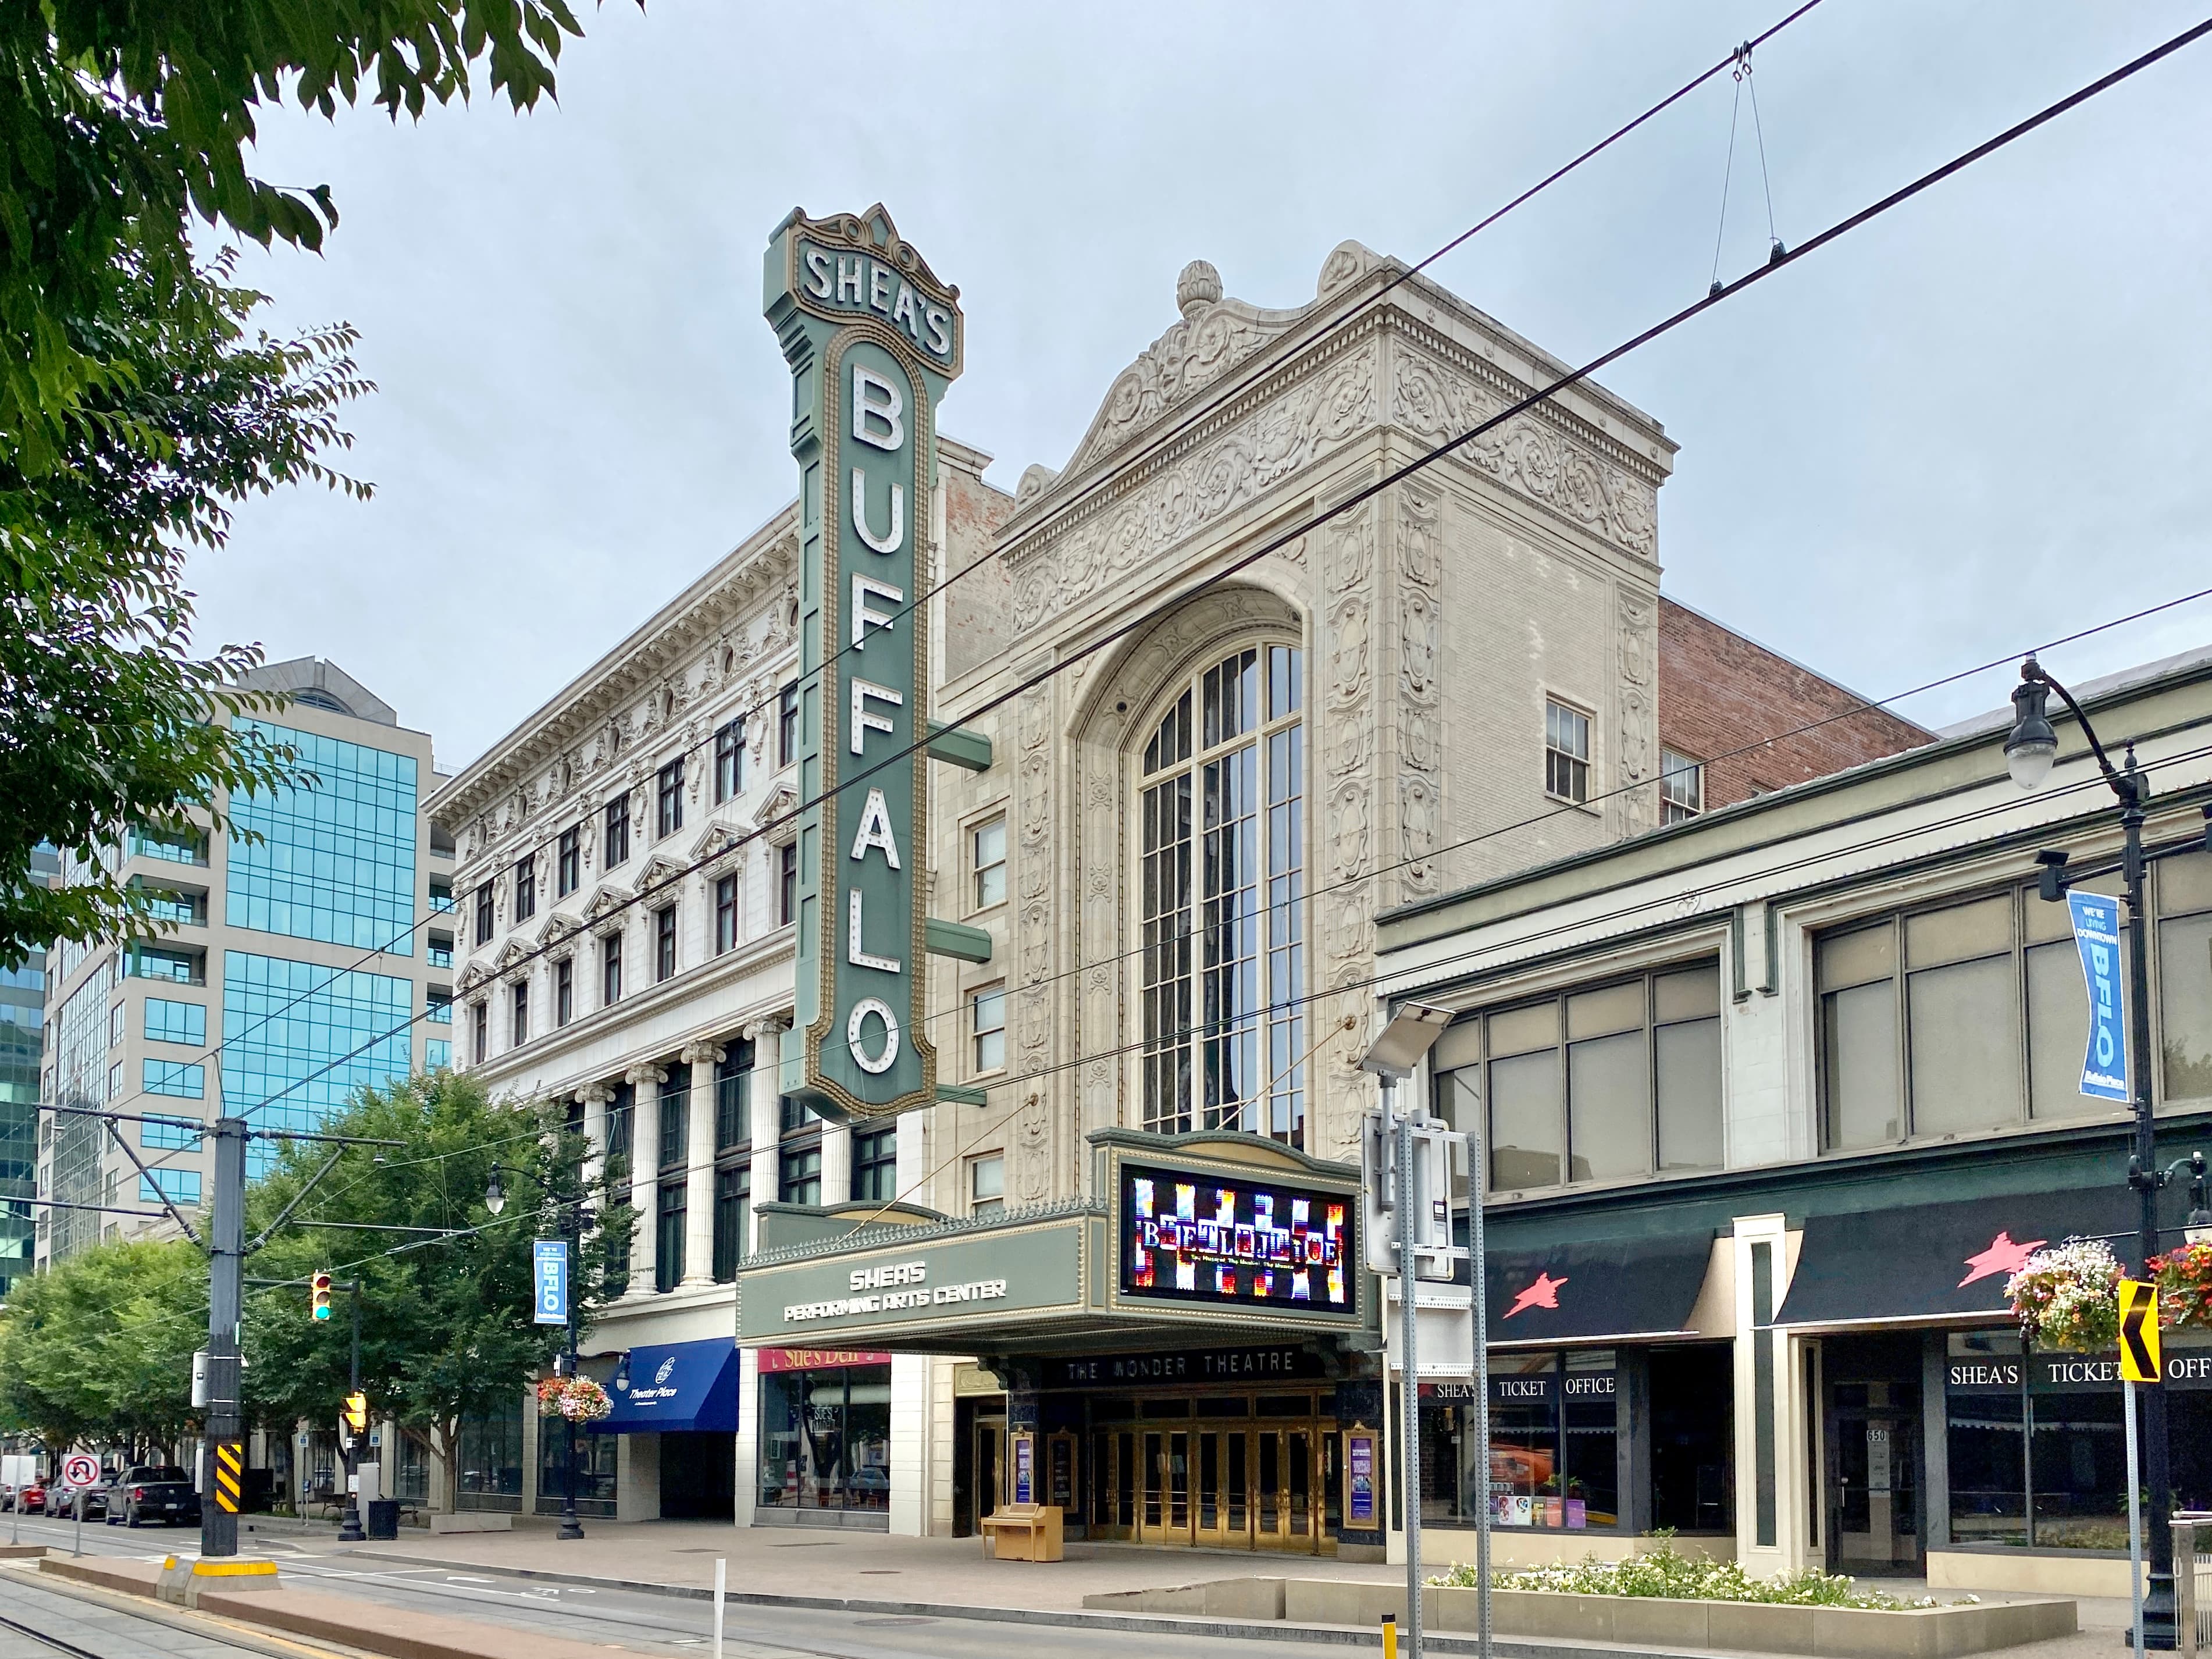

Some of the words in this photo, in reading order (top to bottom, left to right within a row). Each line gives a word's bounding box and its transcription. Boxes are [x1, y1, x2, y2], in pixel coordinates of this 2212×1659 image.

[805, 245, 950, 356] SHEA'S
[848, 363, 905, 1074] BUFFALO
[2082, 906, 2105, 919] WE'RE
[2085, 918, 2107, 931] LIVING
[2076, 928, 2118, 945] DOWNTOWN
[2090, 943, 2114, 1067] BFLO
[543, 1262, 559, 1311] BFLO
[783, 1295, 879, 1322] PERFORMING
[882, 1288, 930, 1310] ARTS
[933, 1279, 1007, 1304] CENTER
[1067, 1362, 1098, 1380] THE
[1113, 1357, 1187, 1377] WONDER
[1204, 1352, 1294, 1373] THEATRE
[1950, 1365, 2019, 1384] SHEA'S
[2047, 1362, 2124, 1383] TICKET
[2168, 1358, 2211, 1379] OFF
[629, 1389, 658, 1399] Theater
[656, 1386, 677, 1397] Place
[1499, 1380, 1547, 1396] TICKET
[1565, 1377, 1615, 1394] OFFICE
[1868, 1430, 1885, 1440] 650
